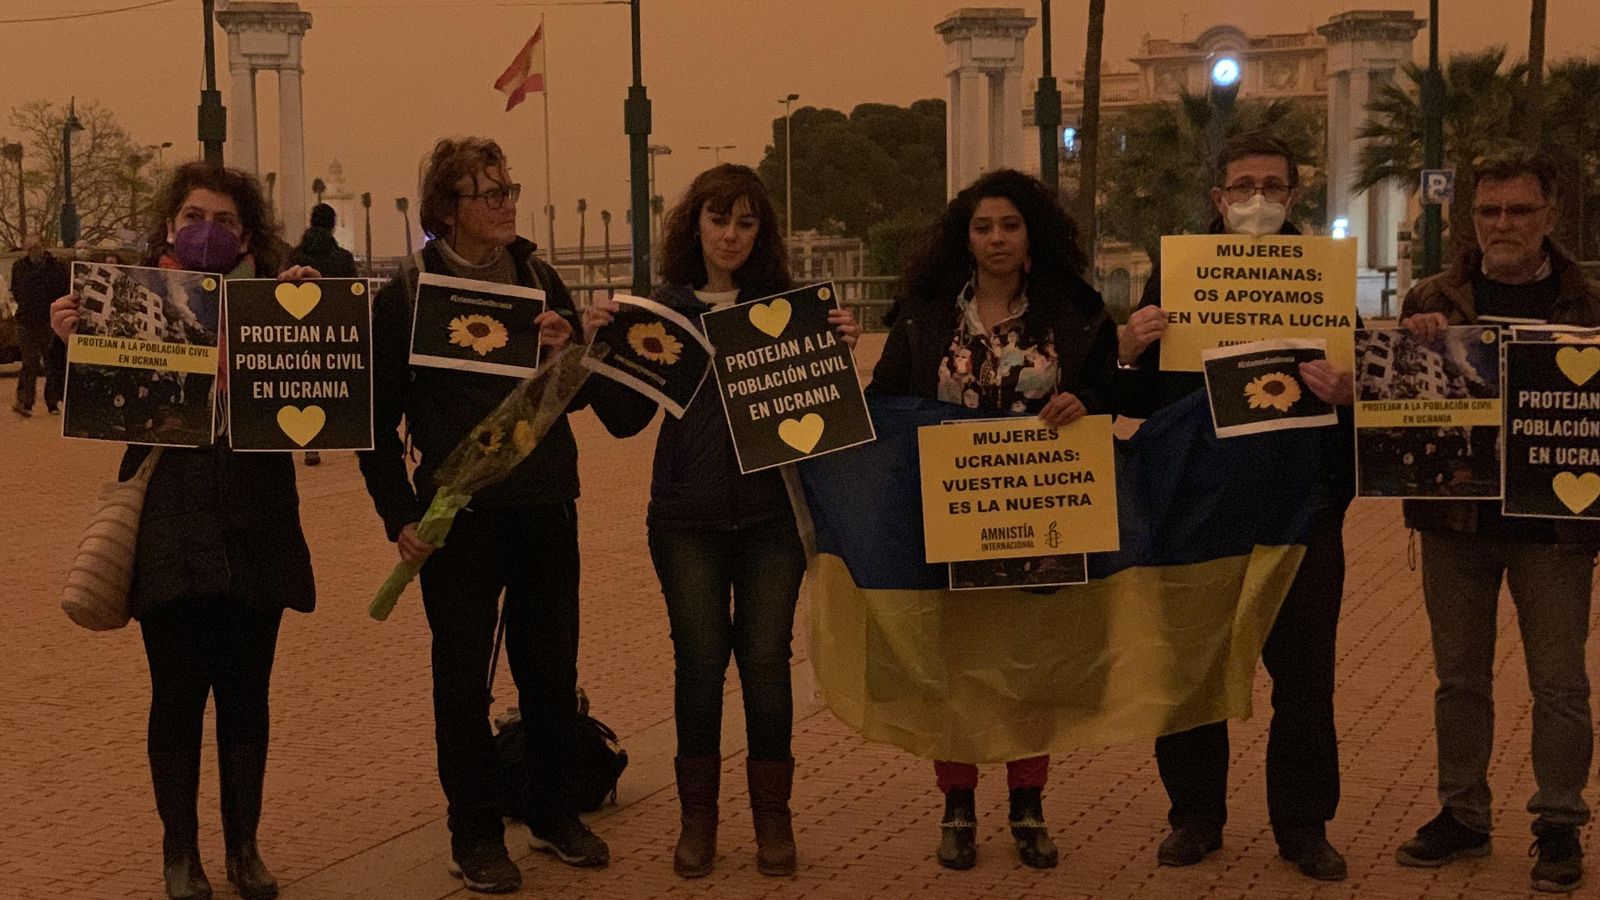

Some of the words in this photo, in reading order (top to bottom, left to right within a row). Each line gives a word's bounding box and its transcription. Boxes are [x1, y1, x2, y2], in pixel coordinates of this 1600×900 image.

[1216, 244, 1304, 258] MUJERES
[1196, 266, 1323, 282] UCRANIANAS:
[1194, 289, 1219, 302] OS
[1224, 290, 1324, 304] APOYAMOS
[1168, 312, 1191, 324] EN
[1197, 312, 1284, 326] VUESTRA
[1289, 314, 1351, 328] LUCHA
[239, 325, 319, 343] PROTEJAN
[325, 326, 335, 343] A
[338, 325, 360, 344] LA
[76, 336, 119, 349] PROTEJAN
[120, 340, 126, 350] A
[127, 342, 138, 352] LA
[139, 342, 187, 355] POBLACIÓN
[188, 346, 211, 358] CIVIL
[725, 338, 801, 373] PROTEJAN
[804, 336, 815, 353] A
[816, 330, 837, 350] LA
[118, 353, 130, 364] EN
[131, 355, 169, 367] UCRANIA
[235, 350, 322, 371] POBLACIÓN
[325, 353, 366, 371] CIVIL
[727, 364, 808, 399] POBLACIÓN
[810, 355, 848, 377] CIVIL
[252, 380, 275, 399] EN
[279, 380, 350, 399] UCRANIA
[749, 400, 771, 421] EN
[773, 383, 841, 415] UCRANIA
[1362, 403, 1402, 412] PROTEJAN
[1403, 402, 1410, 411] A
[1411, 402, 1421, 411] LA
[1423, 400, 1470, 411] POBLACIÓN
[1471, 401, 1493, 410] CIVIL
[1518, 390, 1600, 410] PROTEJAN
[1403, 415, 1415, 424] EN
[1416, 414, 1452, 423] UCRANIA
[1512, 417, 1600, 436] POBLACIÓN
[973, 428, 1059, 446] MUJERES
[955, 449, 1080, 469] UCRANIANAS:
[1528, 446, 1551, 465] EN
[943, 475, 1028, 492] VUESTRA
[1034, 470, 1095, 487] LUCHA
[949, 501, 971, 515] ES
[977, 499, 1000, 513] LA
[1006, 493, 1092, 511] NUESTRA
[981, 522, 1035, 541] AMNISTÍA
[981, 540, 1035, 551] INTERNACIONAL
